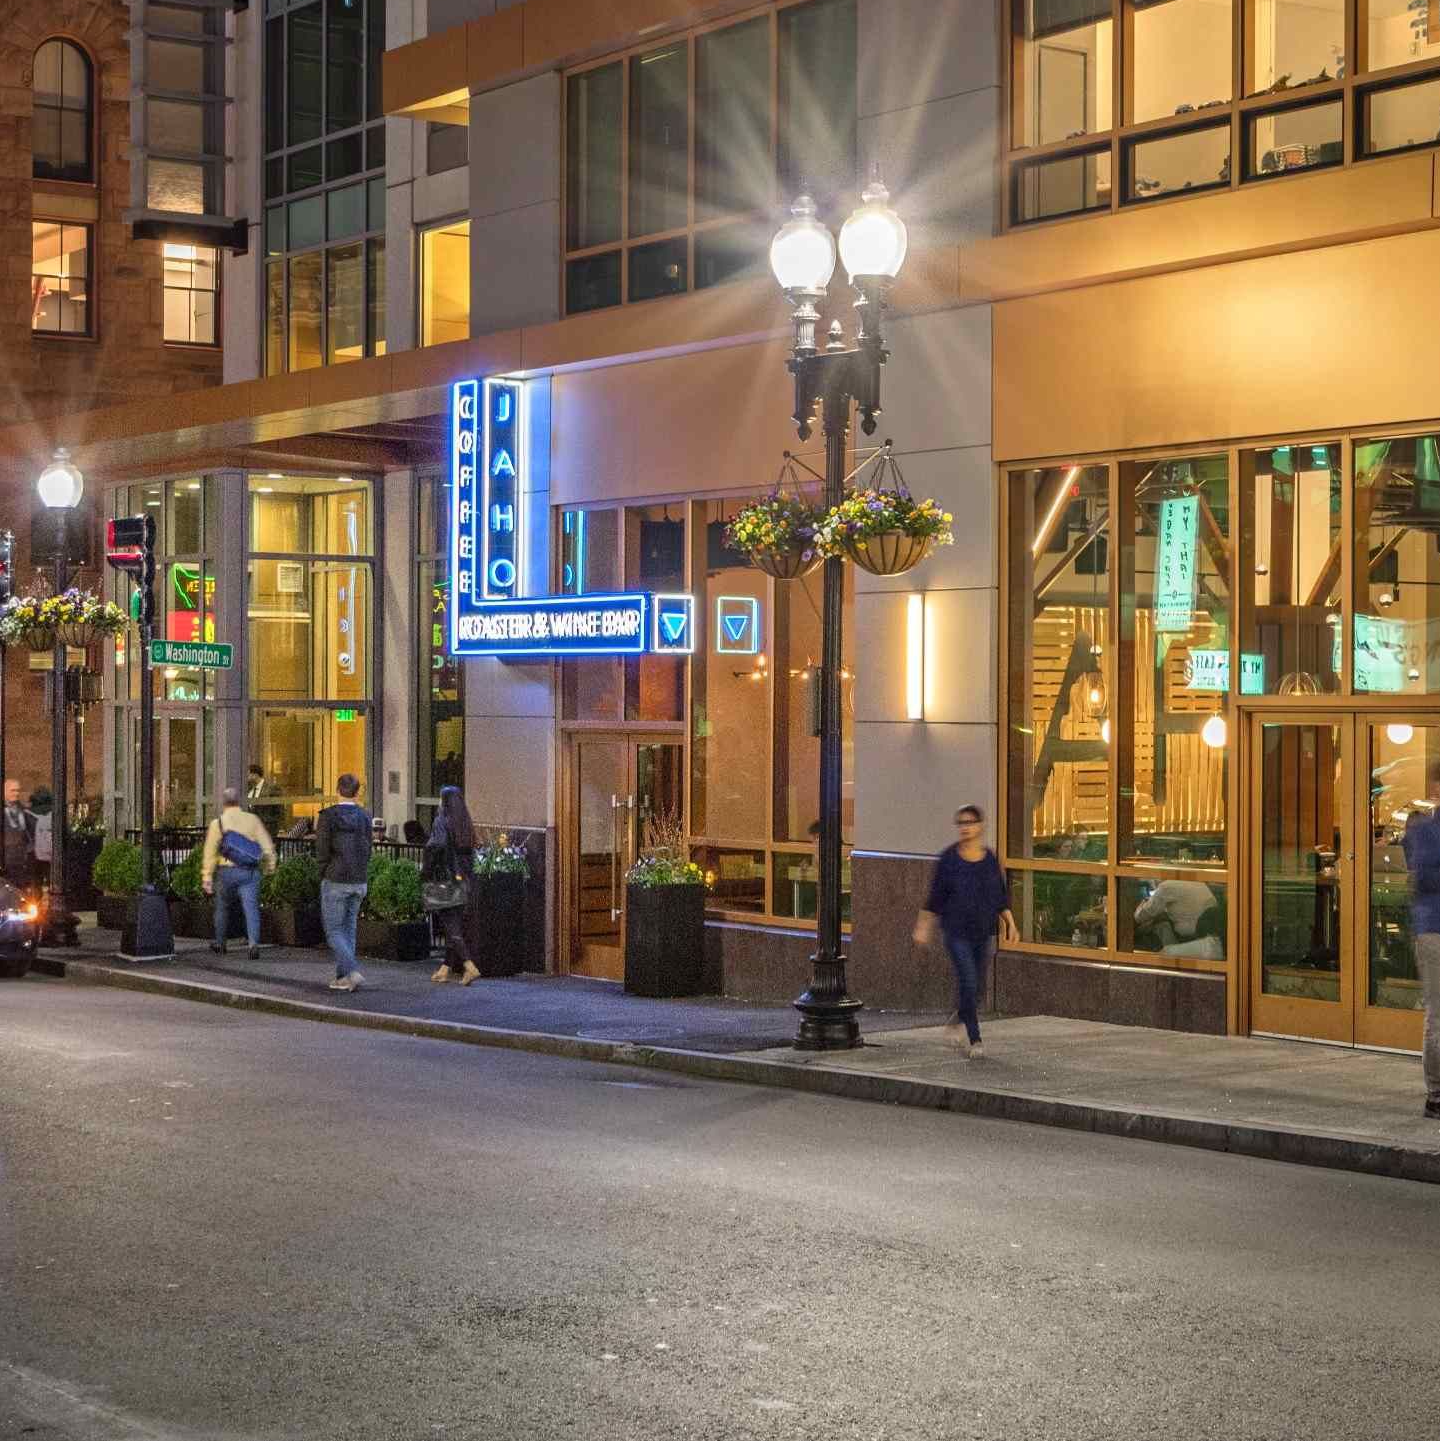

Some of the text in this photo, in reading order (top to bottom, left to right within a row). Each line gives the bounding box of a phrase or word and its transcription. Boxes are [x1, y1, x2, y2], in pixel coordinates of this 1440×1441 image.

[459, 396, 474, 593] COFFEE
[491, 394, 516, 587] JAHO
[165, 643, 220, 666] Washington
[459, 614, 532, 640] ROASTER
[550, 611, 601, 637] WINE
[602, 610, 640, 637] BAR
